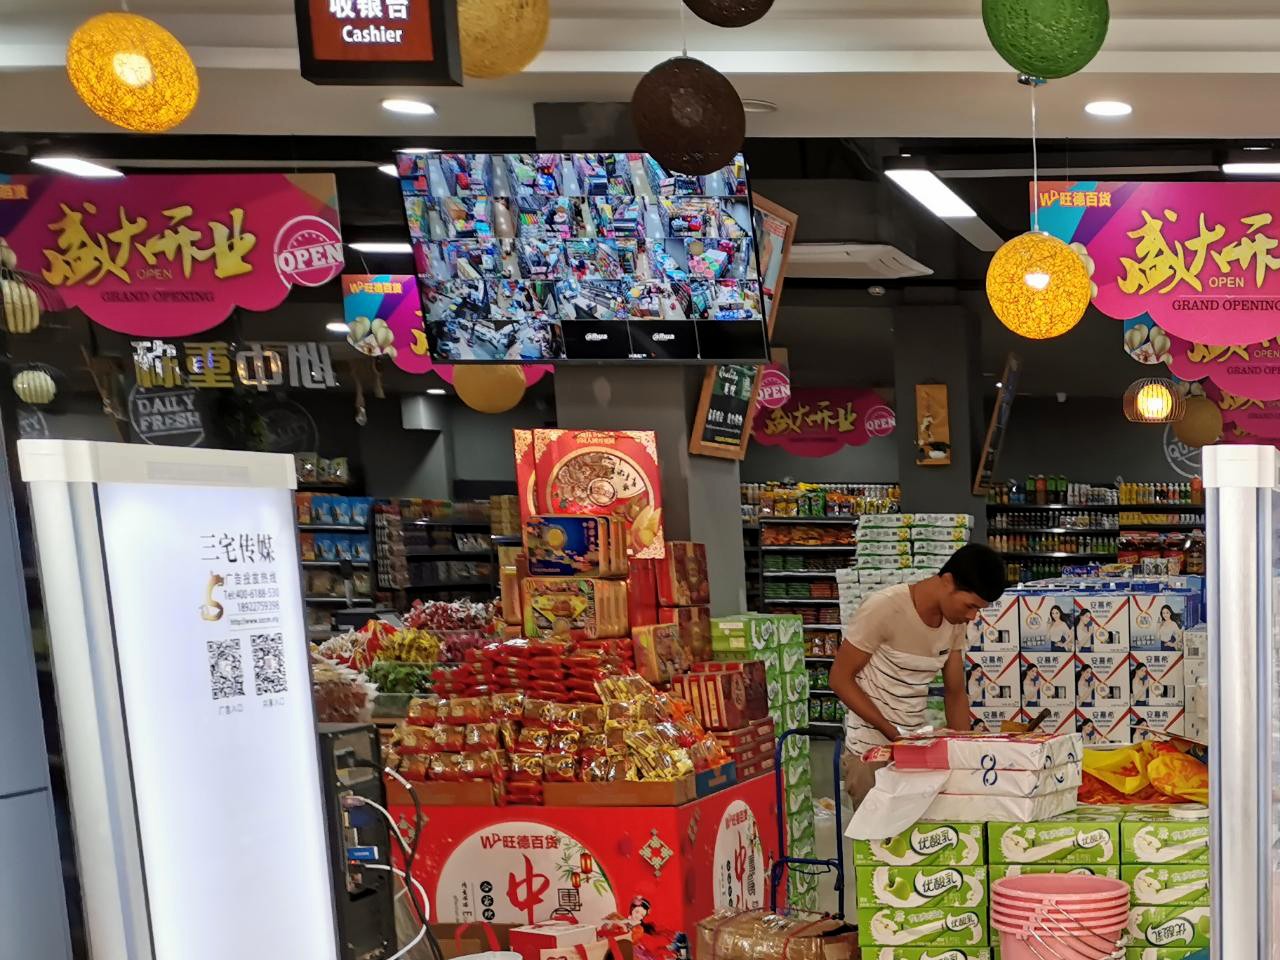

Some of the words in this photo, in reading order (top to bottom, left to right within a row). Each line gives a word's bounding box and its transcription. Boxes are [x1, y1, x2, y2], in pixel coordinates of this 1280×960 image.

[342, 25, 403, 43] Cashier
[1059, 191, 1111, 208] 旺德百货
[41, 201, 257, 286] 盛大开业
[277, 242, 344, 273] OPEN
[136, 267, 173, 280] OPEN
[1209, 276, 1245, 288] OPEN
[101, 291, 149, 302] GRAND
[152, 291, 215, 302] OPENING
[1172, 299, 1220, 311] GRAND
[1253, 350, 1280, 359] OPEN
[1227, 366, 1257, 375] GRAND
[136, 394, 196, 414] DAILY
[140, 411, 202, 432] FRESH
[866, 417, 896, 430] OPEN
[200, 532, 276, 563] 三宅传媒
[981, 656, 1003, 664] 安慕希
[1036, 656, 1059, 664] 安慕希
[1091, 657, 1113, 665] 安慕希
[1146, 655, 1168, 663] 安慕希
[1092, 711, 1114, 719] 安慕希
[1147, 710, 1168, 718] 安慕希
[502, 834, 559, 850] 旺德百货
[917, 828, 957, 850] 优酸乳
[1081, 830, 1109, 846] 优酸乳
[922, 871, 959, 892] 优酸乳
[951, 912, 977, 928] 优酸乳
[1151, 921, 1188, 945] 优酸乳
